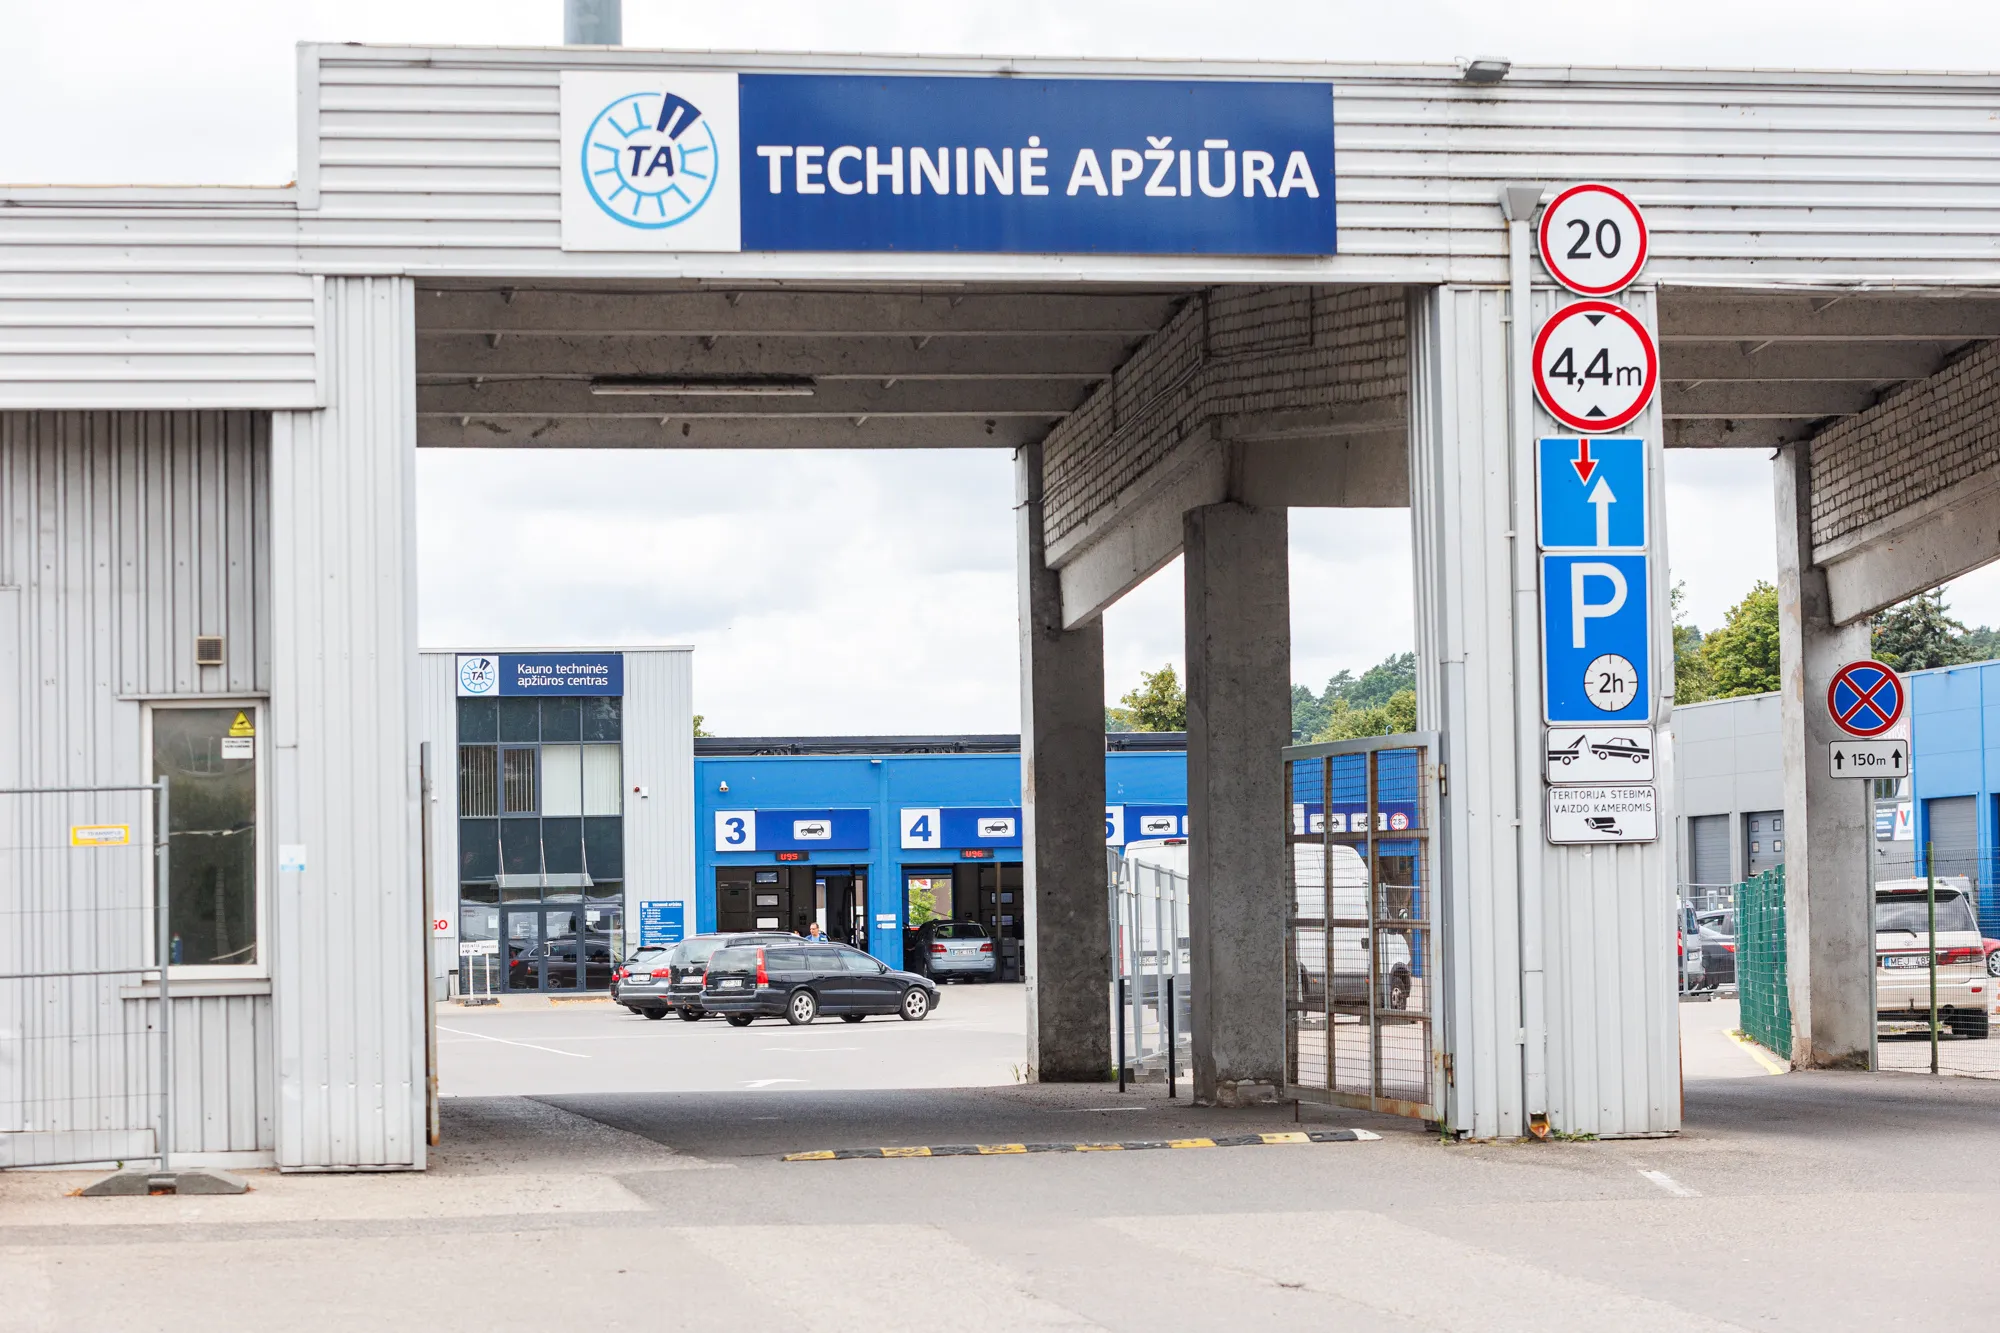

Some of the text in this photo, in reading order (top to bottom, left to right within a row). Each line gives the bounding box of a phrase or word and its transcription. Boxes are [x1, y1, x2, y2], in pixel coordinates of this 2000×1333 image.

[627, 145, 675, 178] TA
[756, 136, 1320, 198] TECHNINĖ APŽIŪRA
[1566, 218, 1622, 260] 20
[1549, 347, 1642, 393] 4,4m
[1571, 562, 1628, 649] P
[471, 671, 484, 681] TA
[517, 663, 609, 674] Kauno techninės
[517, 675, 608, 688] apžiūros centras
[1599, 672, 1624, 693] 2h
[1552, 789, 1652, 800] TERITORIJA STEBIMA
[1554, 802, 1652, 813] VAIZDO KAMEROMIS
[725, 817, 746, 845] 3
[909, 815, 932, 842] 4
[1890, 956, 1910, 966] MEJ
